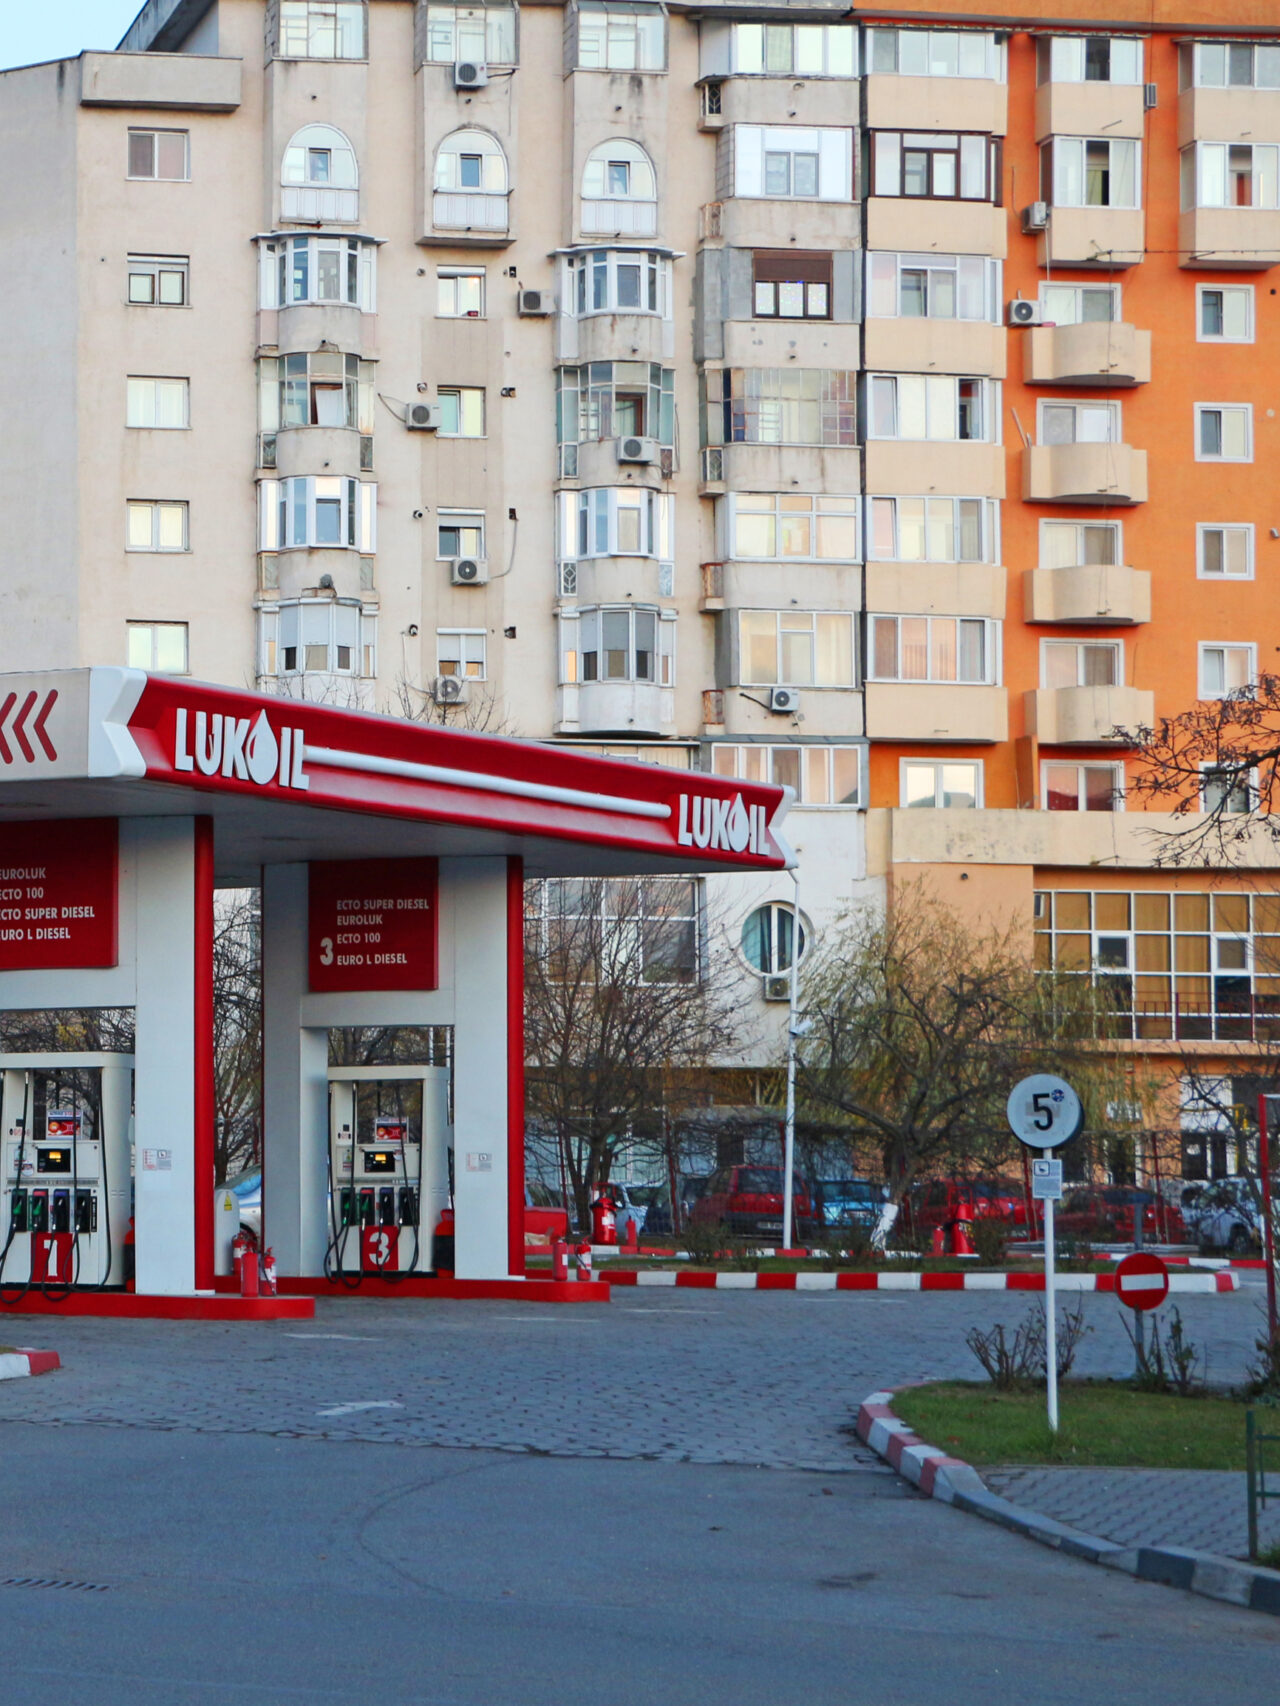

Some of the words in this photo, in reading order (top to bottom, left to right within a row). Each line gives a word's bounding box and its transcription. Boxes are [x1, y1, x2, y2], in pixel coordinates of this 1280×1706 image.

[175, 707, 309, 791] LUKOIL
[678, 792, 770, 856] LUKOIL
[26, 887, 44, 899] 100
[337, 899, 360, 911] ECTO
[363, 899, 394, 910] SUPER
[397, 898, 429, 910] DIESEL
[25, 907, 58, 920] SUPER
[61, 906, 95, 919] DIESEL
[337, 914, 383, 926] EUROLUK
[27, 928, 33, 940] L
[36, 927, 71, 940] DIESEL
[337, 934, 361, 944] ECTO
[364, 933, 381, 943] 100
[320, 937, 334, 966] 3
[337, 954, 364, 965] EURO
[366, 954, 372, 965] L
[374, 953, 407, 964] DIESEL
[1032, 1092, 1053, 1131] 5
[368, 1231, 390, 1265] 3
[43, 1239, 58, 1277] 1
